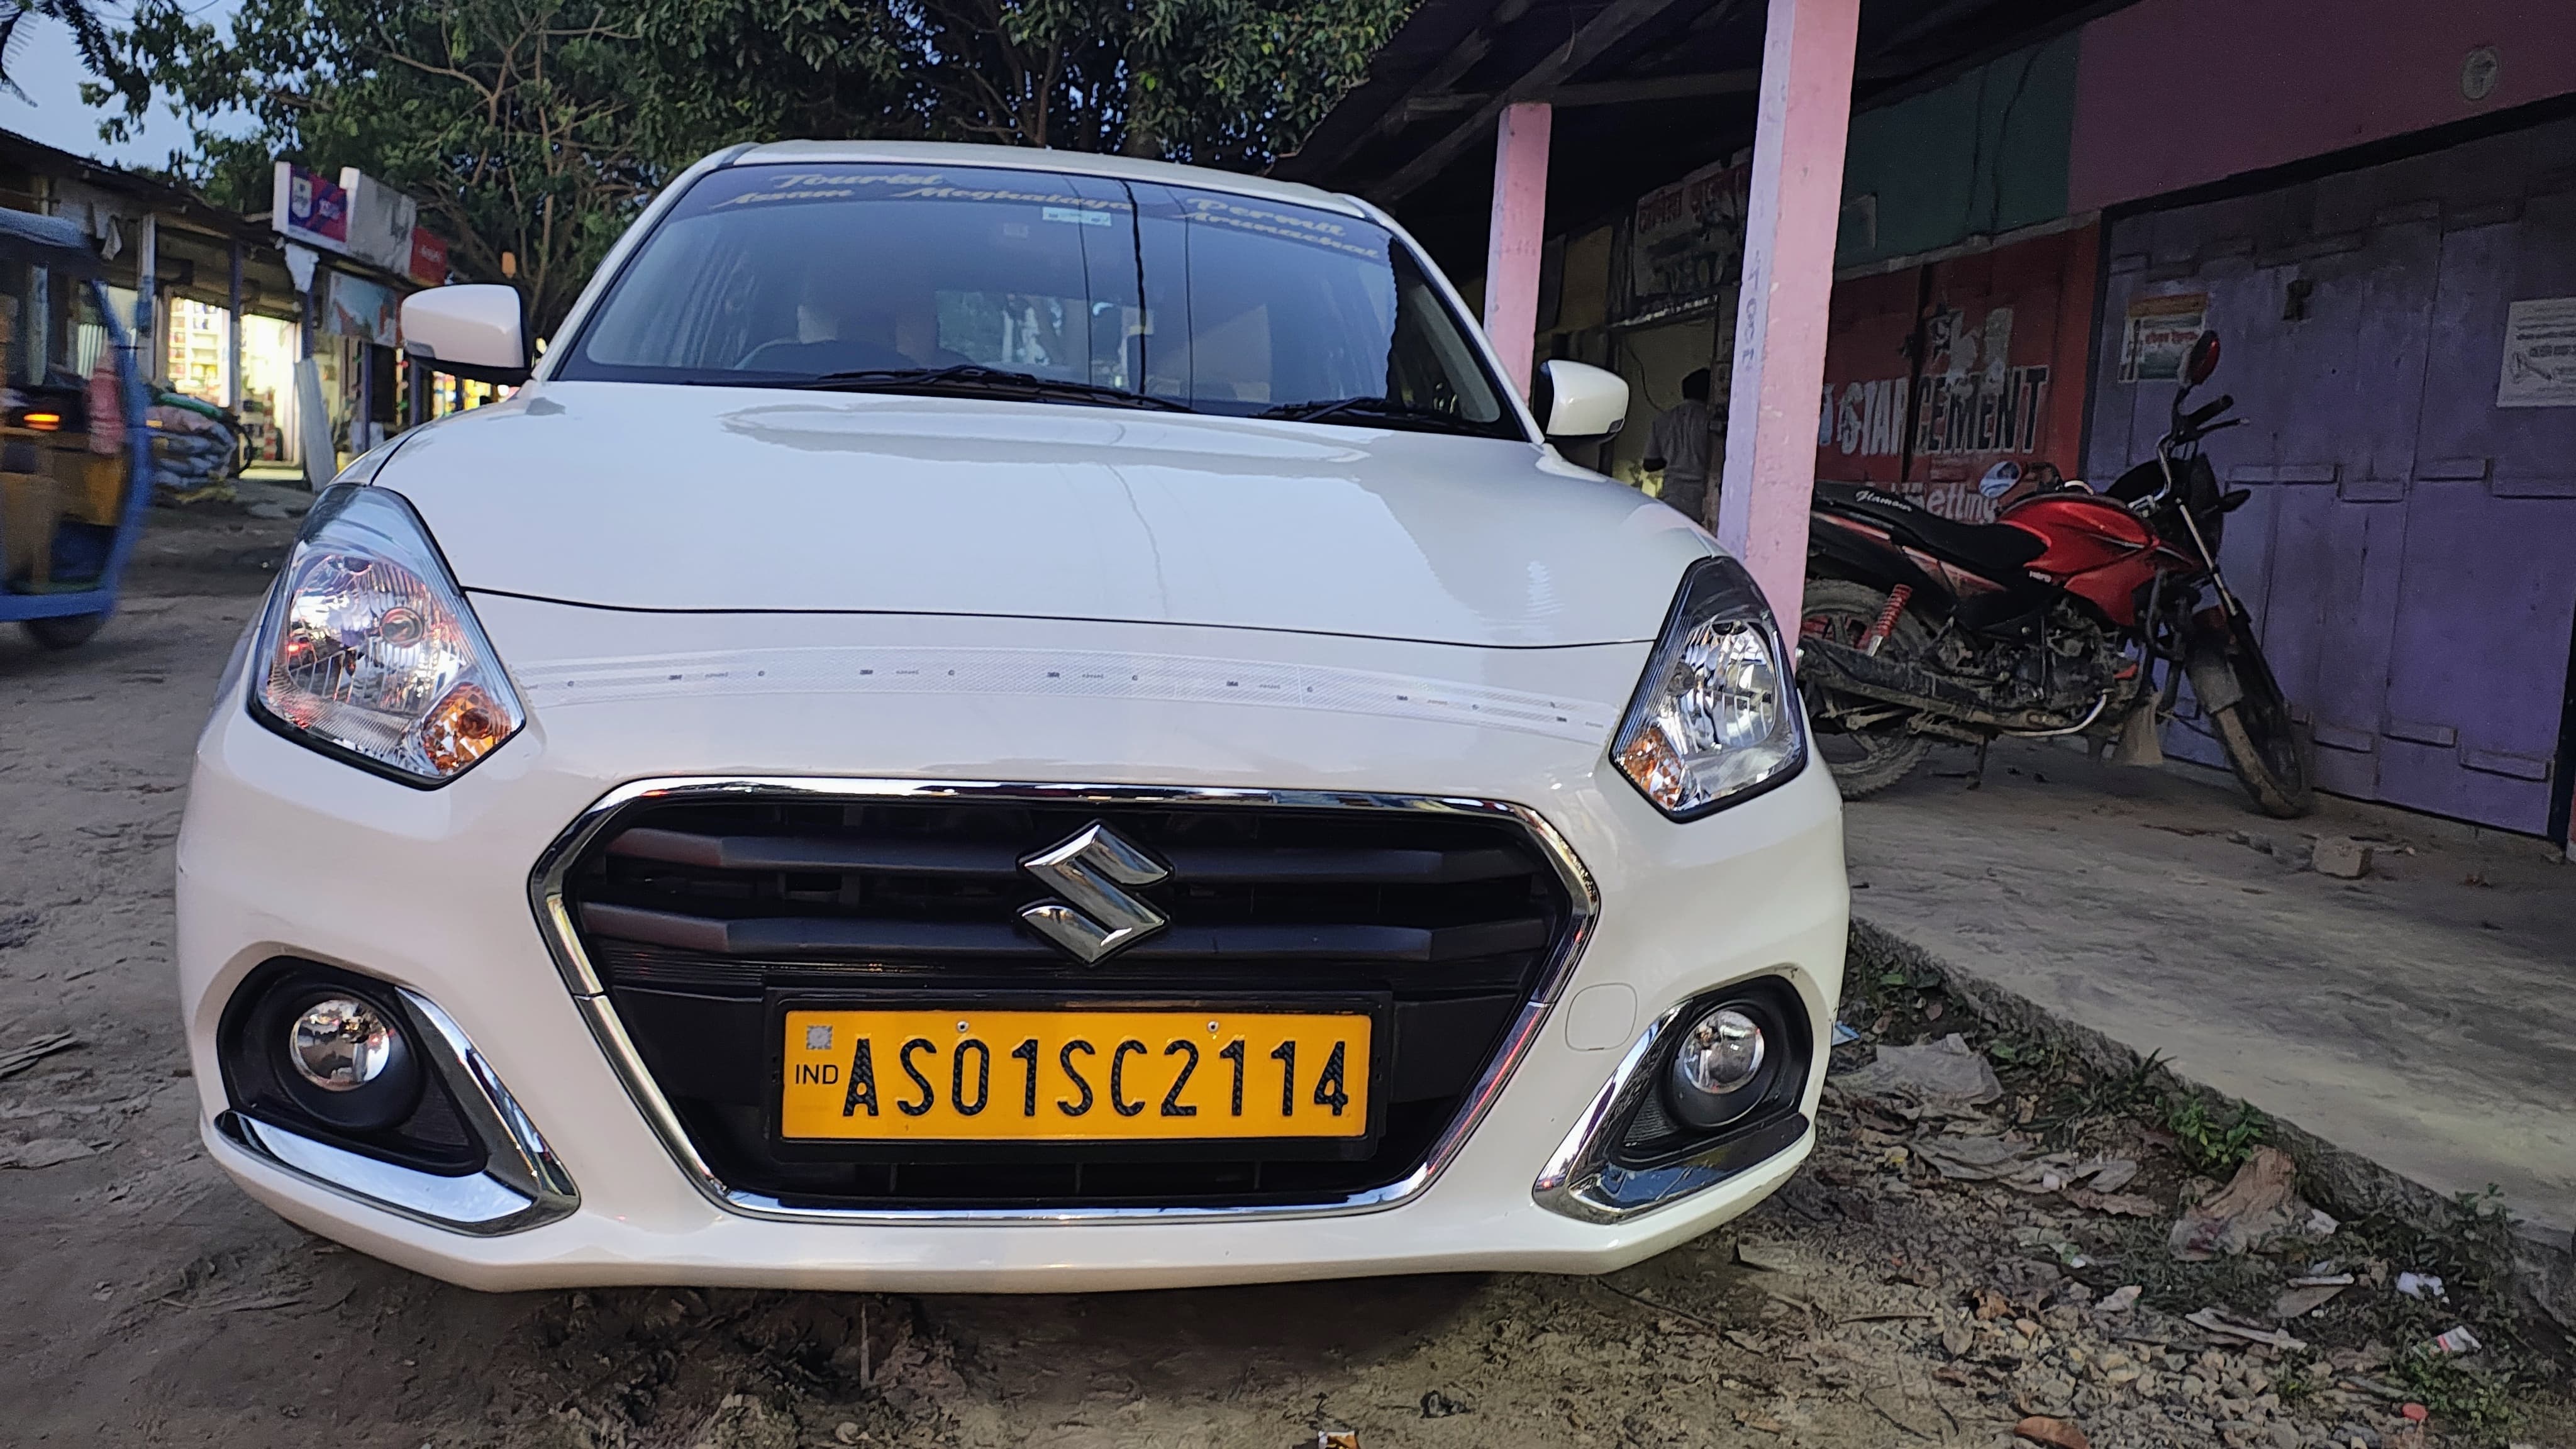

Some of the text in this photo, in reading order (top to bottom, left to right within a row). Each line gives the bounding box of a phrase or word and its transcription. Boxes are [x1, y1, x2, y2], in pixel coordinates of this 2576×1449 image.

[770, 174, 1346, 236] Tourist Permit
[1913, 365, 2050, 456] CEMENT
[796, 1036, 1350, 1118] IND AS01SC2114
